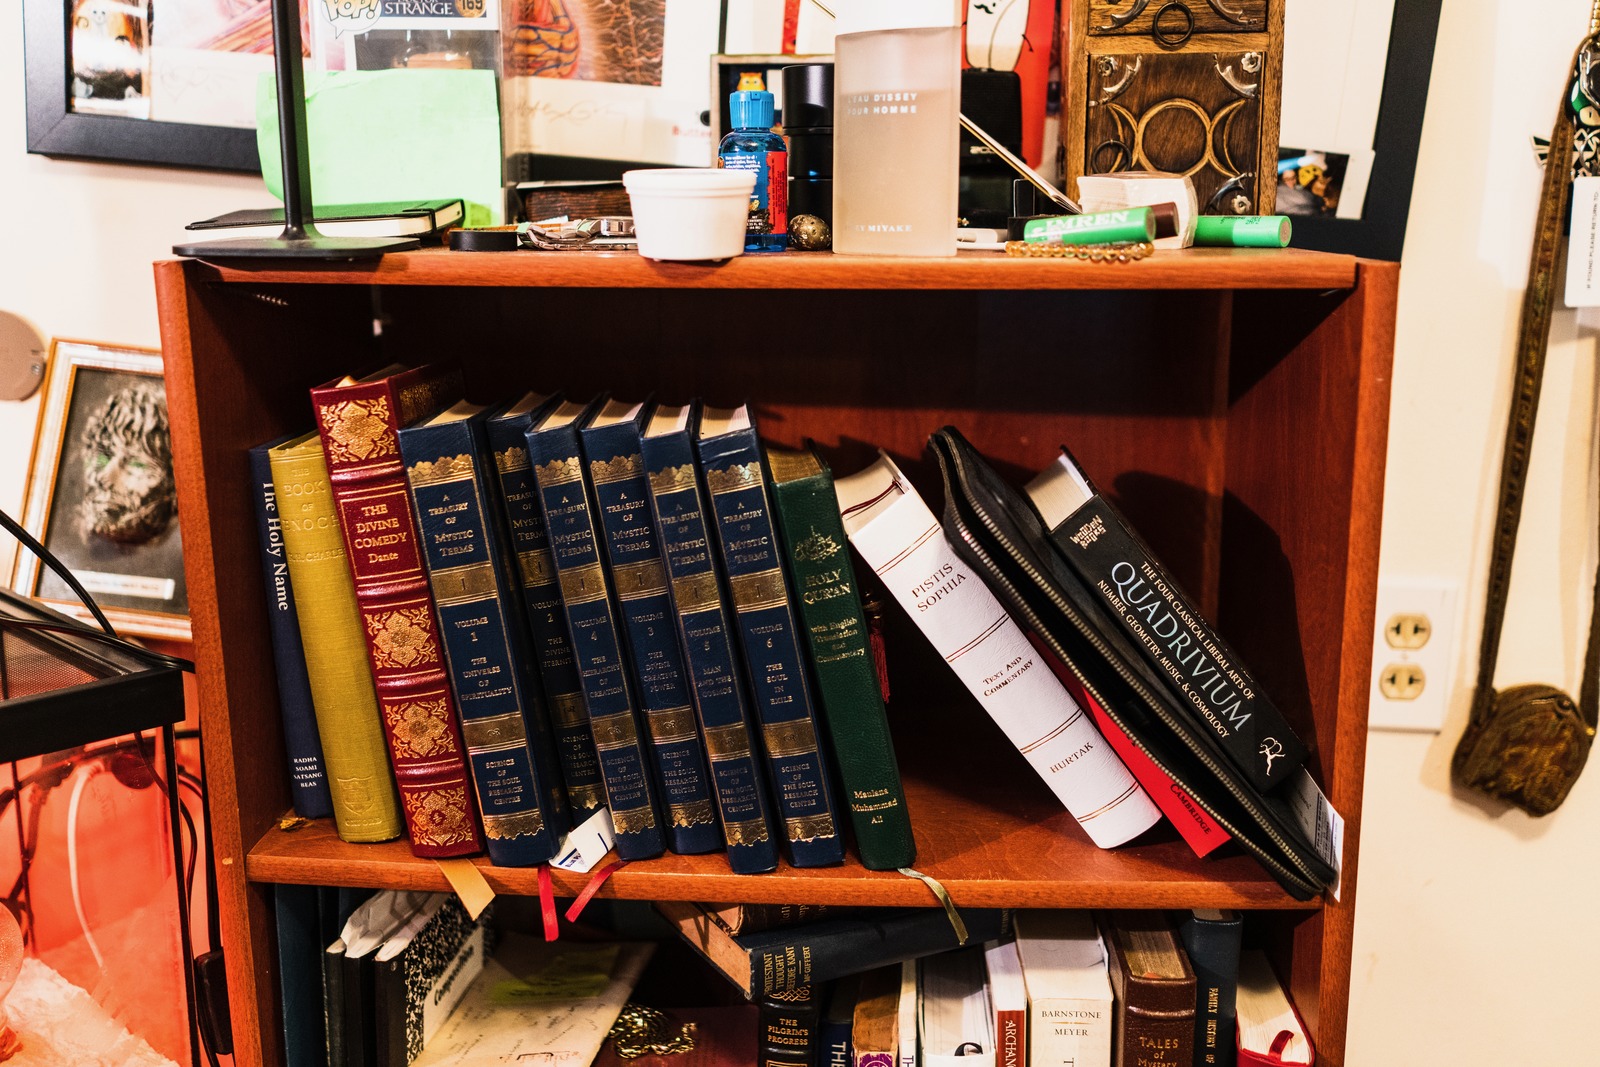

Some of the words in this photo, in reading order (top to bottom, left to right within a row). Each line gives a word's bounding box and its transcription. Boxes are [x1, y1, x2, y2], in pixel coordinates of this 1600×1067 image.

[385, 2, 453, 15] STRANGE
[462, 0, 483, 10] 169
[874, 92, 918, 102] D'ISSEY
[873, 105, 917, 113] HOMME
[868, 224, 913, 232] MIYAKE
[283, 480, 326, 497] BOOK
[620, 492, 627, 500] A
[301, 503, 314, 512] OF
[361, 504, 388, 516] THE
[428, 502, 468, 516] TREASURY
[548, 503, 586, 517] TREASURY
[606, 500, 645, 513] TREASURY
[623, 514, 633, 522] OF
[724, 509, 762, 523] TREASURY
[356, 518, 399, 533] DIVINE
[266, 517, 282, 558] Holy
[434, 530, 474, 544] MYSTIC
[612, 526, 650, 540] MYSTIC
[354, 532, 408, 549] COMEDY
[440, 544, 474, 556] TERMS
[617, 541, 650, 553] TERMS
[369, 552, 399, 564] Dante
[805, 568, 842, 587] HOLY
[911, 562, 954, 598] PISTIS
[273, 562, 288, 611] Name
[917, 572, 967, 613] SOPHIA
[455, 616, 488, 628] VOLUME
[547, 613, 554, 622] 2
[575, 616, 608, 628] VOLUME
[632, 612, 664, 623] VOLUME
[647, 627, 654, 636] 3
[688, 625, 720, 638] VOLUME
[750, 624, 783, 635] VOLUME
[811, 625, 828, 633] with
[1140, 561, 1158, 581] THE
[1153, 578, 1175, 604] FOUR
[1172, 600, 1206, 641] CLASSICAL
[1203, 639, 1230, 671] LIBERAL
[1226, 669, 1246, 689] ARTS
[1242, 687, 1255, 700] OF
[470, 632, 478, 642] 1
[591, 631, 597, 640] 4
[767, 638, 773, 648] 6
[1111, 561, 1252, 732] QUADRIVIUM
[471, 657, 487, 665] THE
[591, 656, 606, 664] THE
[1097, 579, 1127, 616] NUMBER,
[1125, 614, 1163, 658] GEOMETRY,
[1159, 656, 1184, 685] MUSIC,
[1181, 682, 1191, 693] &
[1188, 690, 1230, 738] COSMOLOGY
[463, 666, 501, 678] UNIVERSE
[703, 666, 721, 675] MAN
[766, 663, 783, 672] THE
[983, 670, 1004, 686] TEXT
[1006, 656, 1022, 671] AND
[766, 674, 789, 683] SOUL
[983, 658, 1034, 697] COMMENTARY
[461, 686, 512, 701] SPIRITUALITY
[590, 686, 623, 698] CREATION
[293, 756, 317, 764] RADHA
[486, 758, 515, 769] SCIENCE
[1049, 742, 1094, 774] HURTAK
[295, 764, 317, 772] SOAMI
[781, 763, 810, 773] SCIENCE
[852, 798, 898, 812] Muhammad
[1170, 783, 1212, 835] CAMBRIDGE
[786, 946, 796, 962] KANT
[764, 952, 773, 995] PROTESTANT
[775, 954, 785, 989] THOUGHT
[786, 965, 796, 990] BEFORE
[1208, 987, 1218, 1014] FAMILY
[1042, 1010, 1101, 1019] BARNSTONE
[780, 1018, 798, 1026] THE
[768, 1025, 809, 1036] PILGRIM'S
[1055, 1028, 1088, 1036] MEYER
[1206, 1019, 1217, 1048] HISTORY
[768, 1035, 808, 1046] PROGRESS
[1140, 1036, 1179, 1049] TALES
[1153, 1050, 1165, 1060] of
